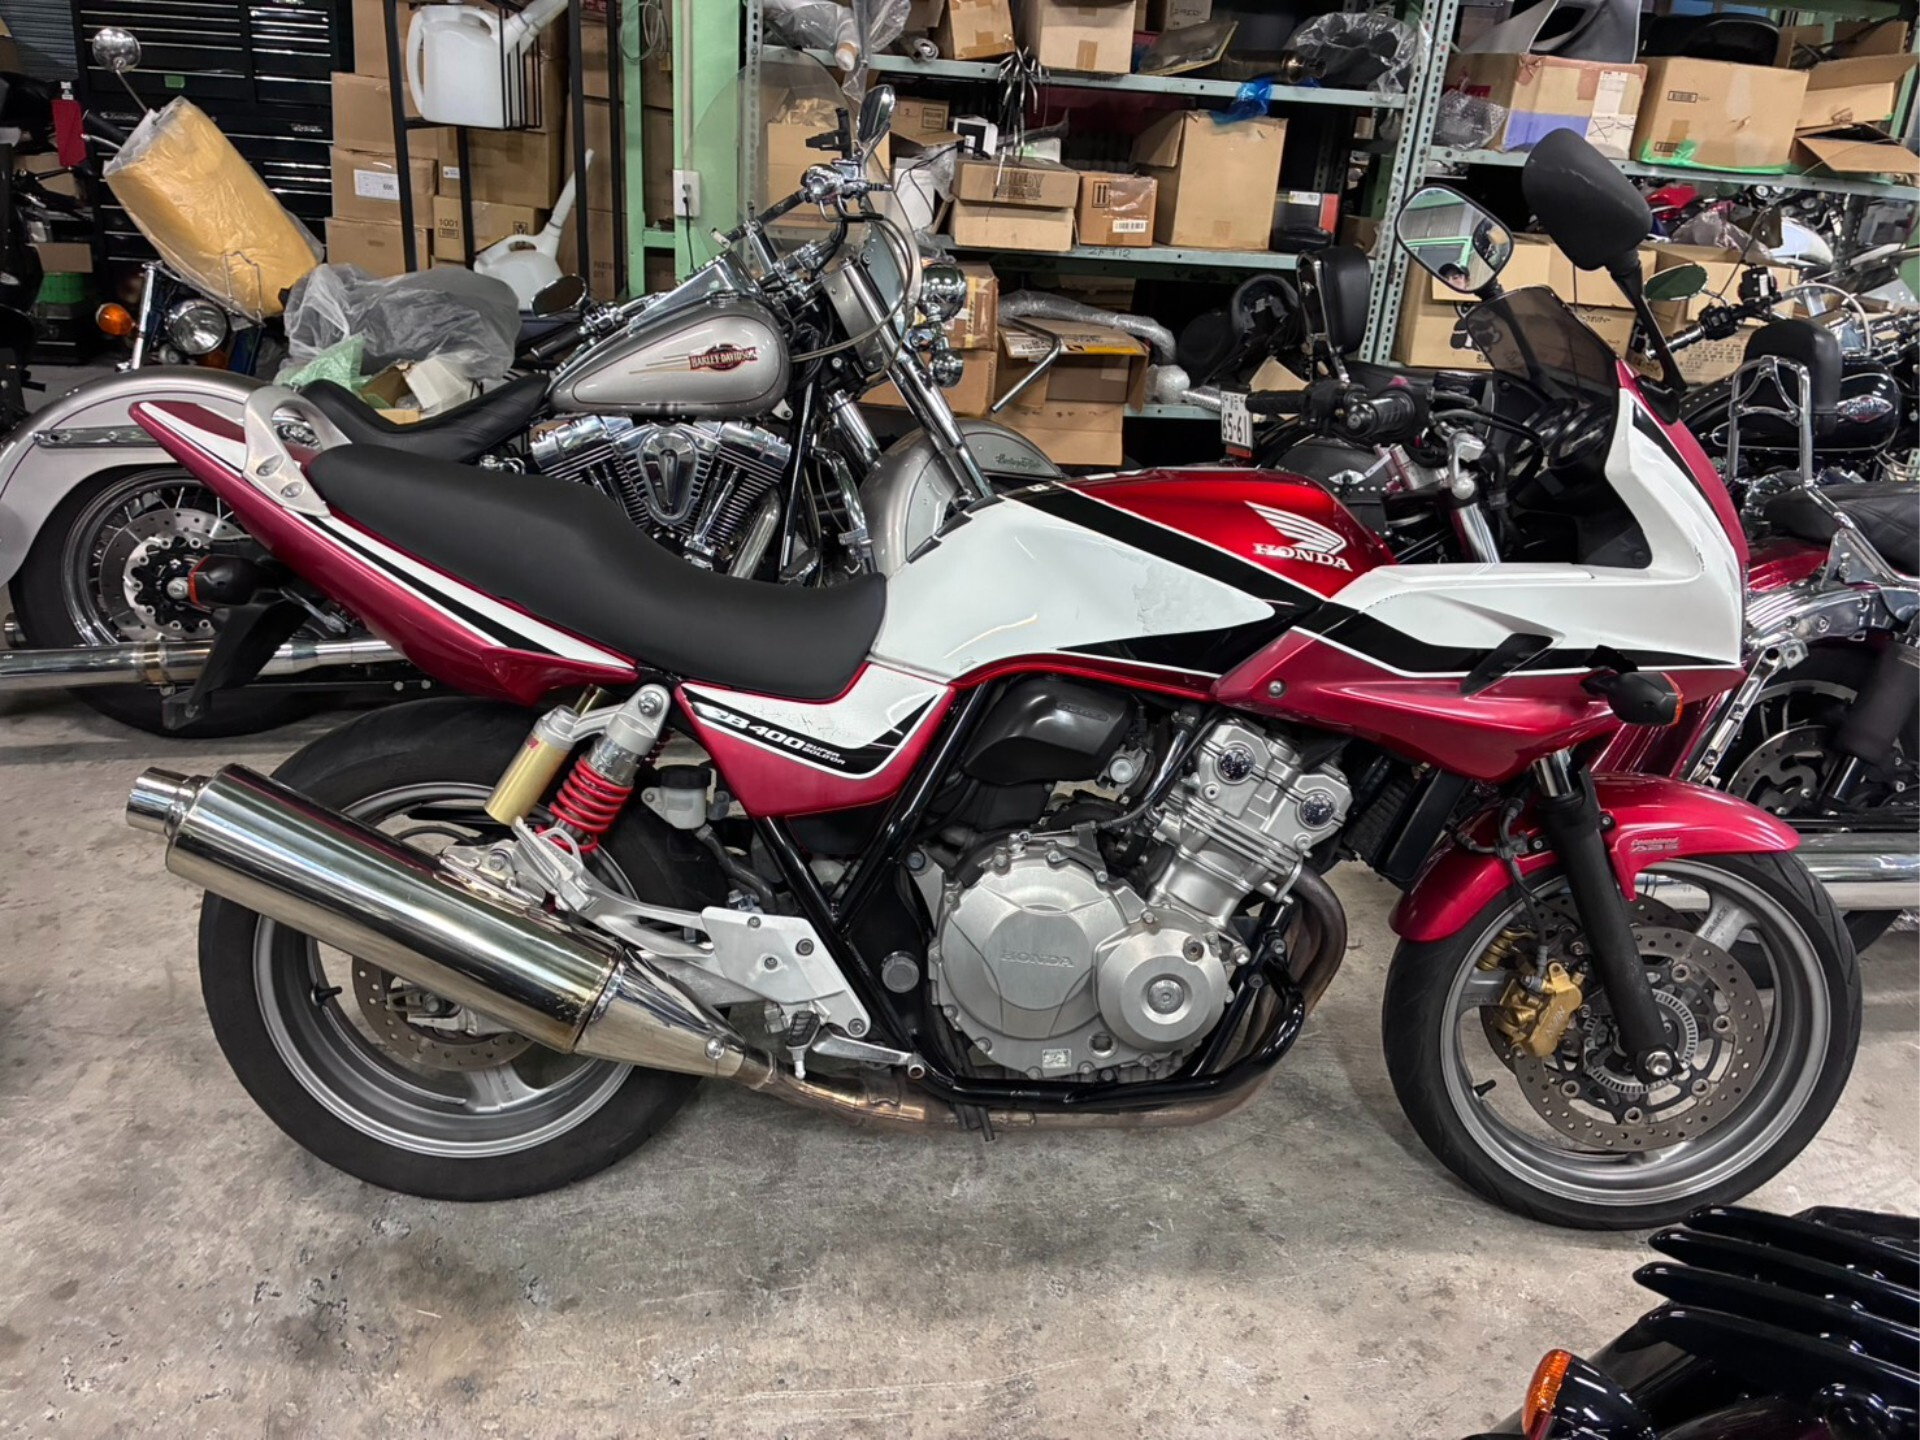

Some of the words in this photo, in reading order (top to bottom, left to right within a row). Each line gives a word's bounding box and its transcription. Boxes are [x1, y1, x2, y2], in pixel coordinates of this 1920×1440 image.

[439, 218, 459, 228] 1001
[1252, 542, 1354, 572] HONDA
[804, 742, 841, 758] SUPER
[1000, 950, 1075, 969] HONDA
